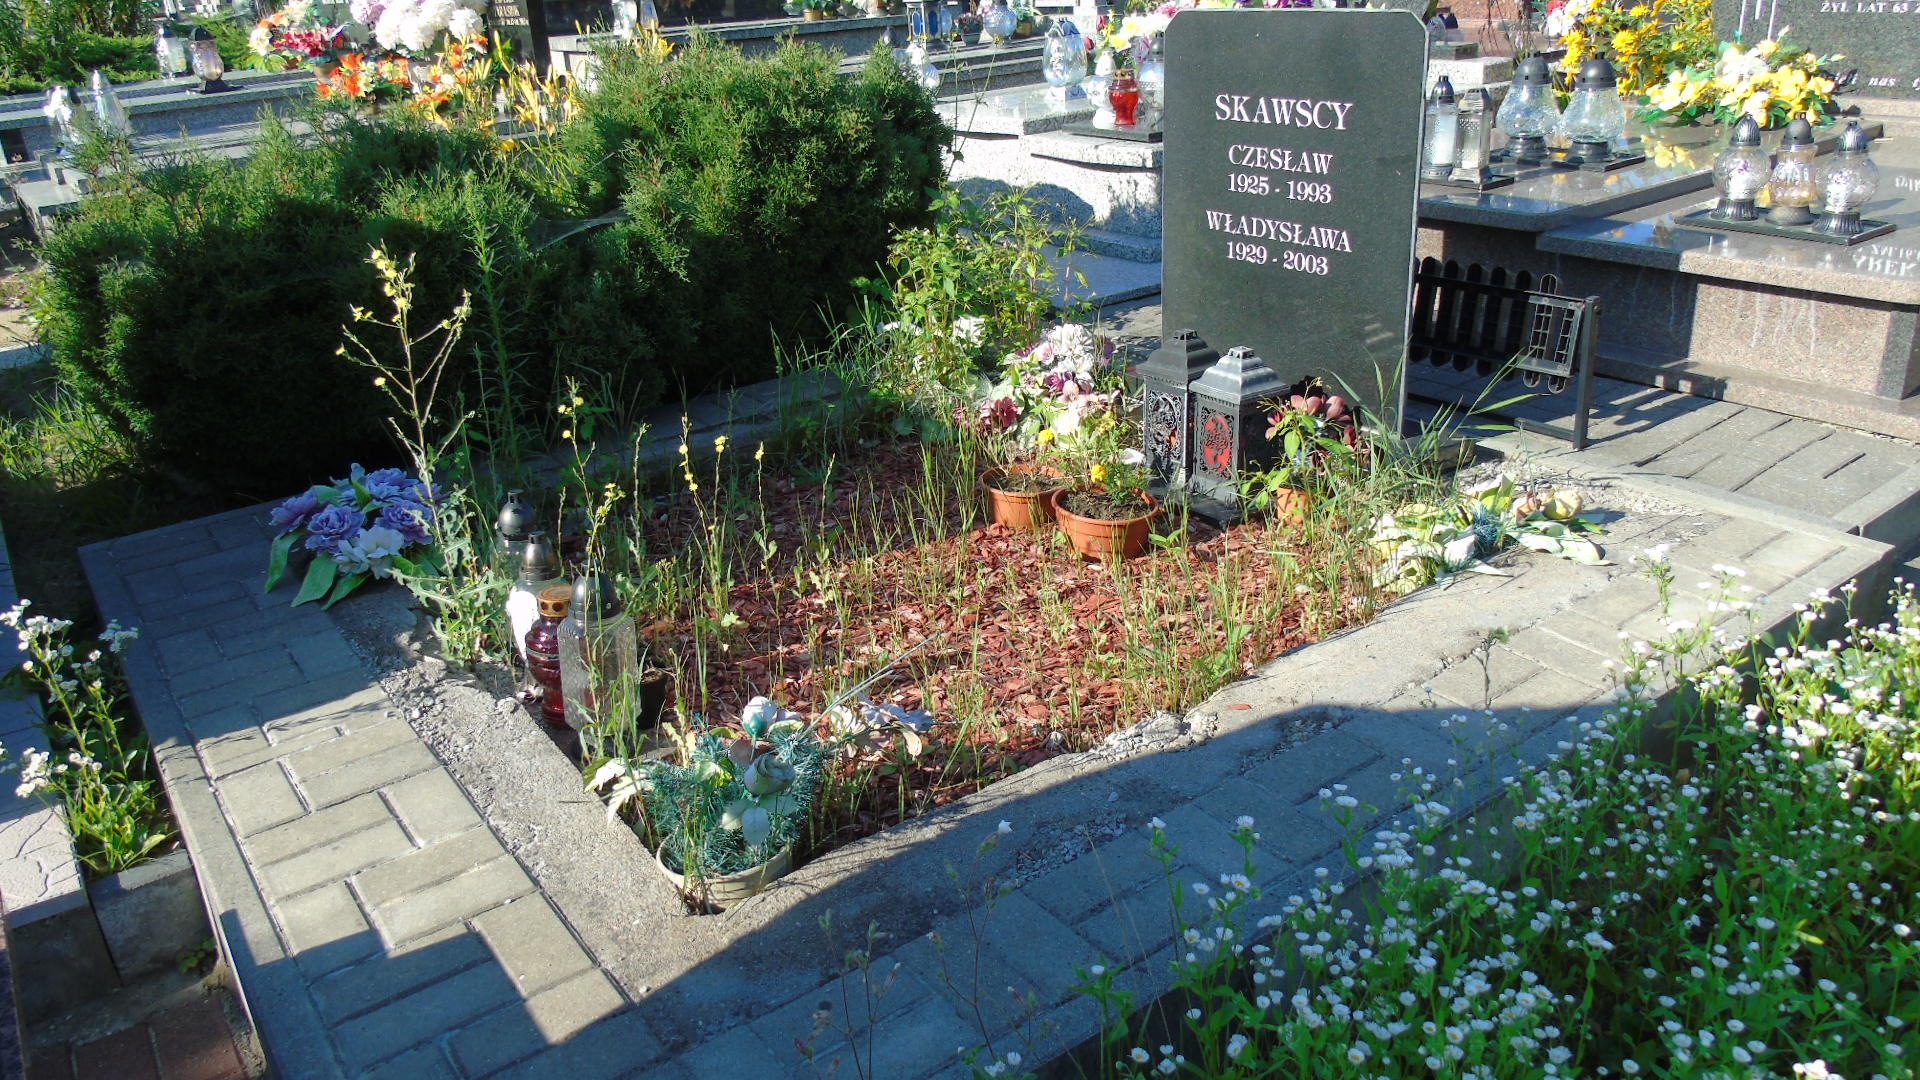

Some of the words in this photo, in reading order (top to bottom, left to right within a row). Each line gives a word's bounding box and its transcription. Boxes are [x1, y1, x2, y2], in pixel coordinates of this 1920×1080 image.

[1856, 3, 1886, 13] LAT
[1892, 3, 1908, 13] 63
[1868, 76, 1896, 87] nas
[1215, 94, 1353, 130] SKAWSCY
[1228, 144, 1333, 175] CZESŁAW
[1227, 173, 1270, 195] 1925
[1286, 180, 1332, 204] 1993
[1206, 209, 1353, 253] WŁADYSŁAWA
[1226, 241, 1267, 265] 1929
[1283, 250, 1328, 275] 2003
